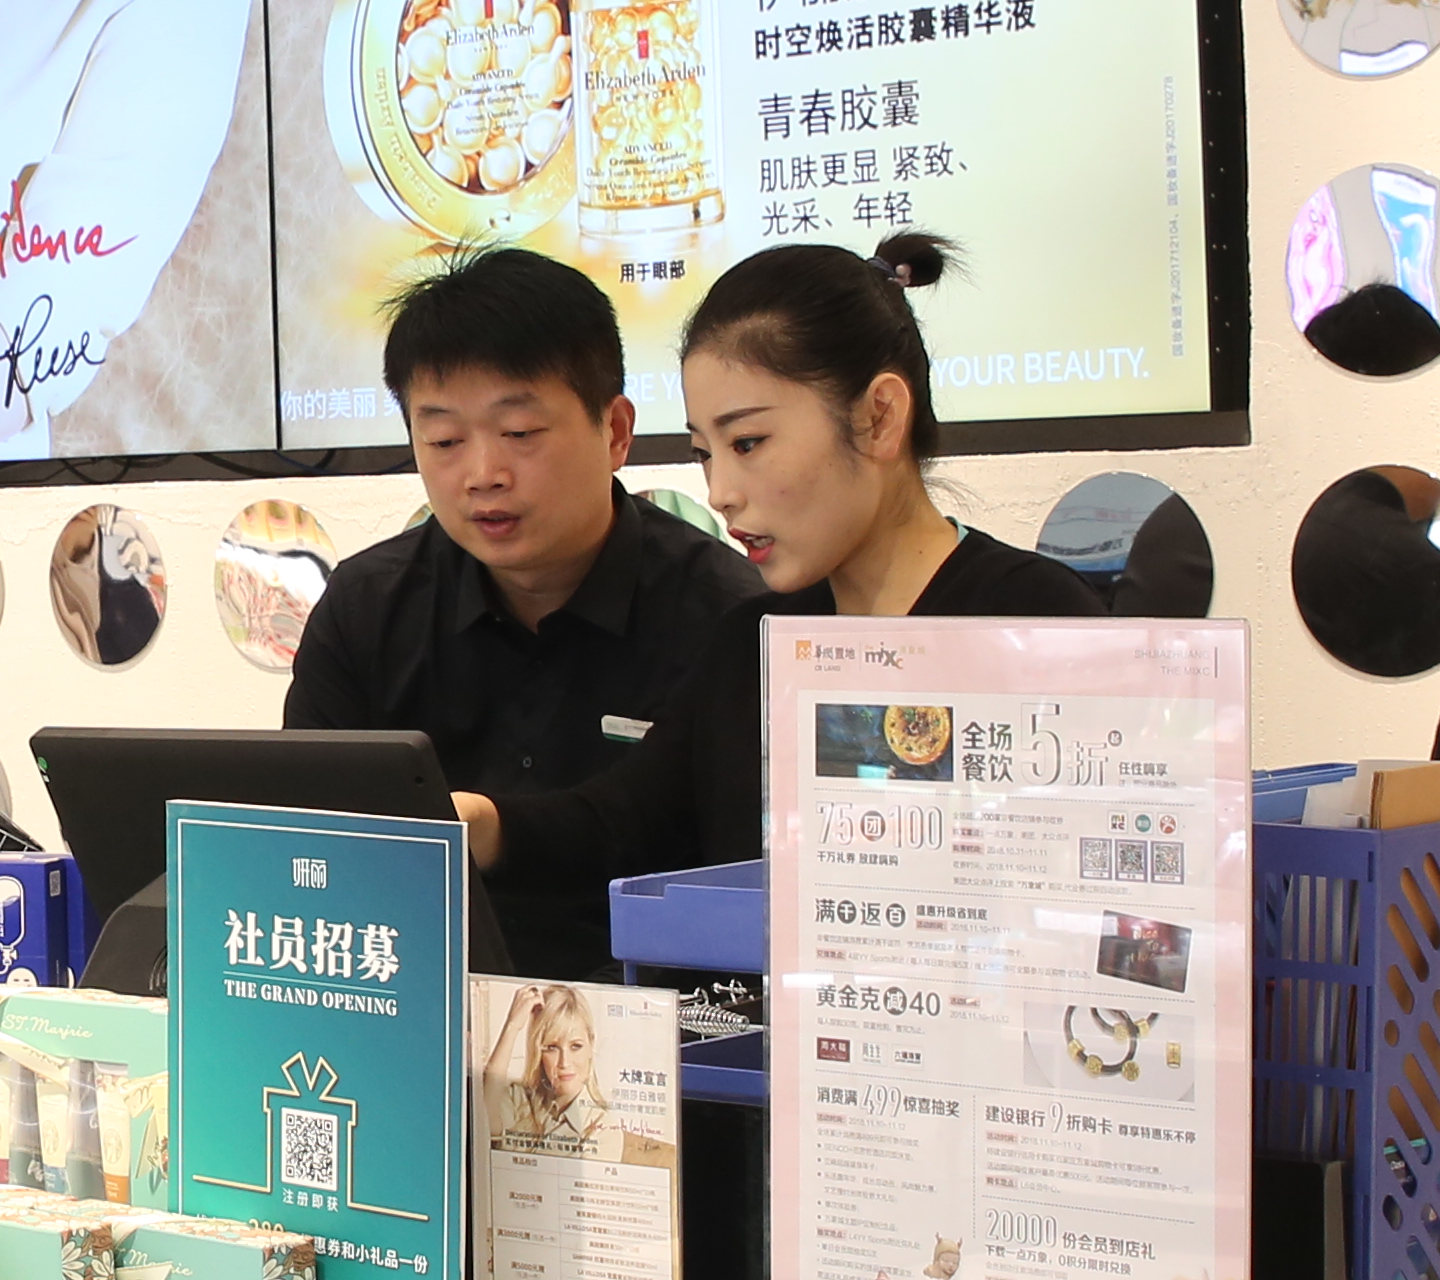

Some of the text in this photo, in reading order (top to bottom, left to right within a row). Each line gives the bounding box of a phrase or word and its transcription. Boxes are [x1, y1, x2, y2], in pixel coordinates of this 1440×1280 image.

[583, 61, 707, 92] Elizabeth Arden
[758, 80, 920, 141] 青春胶囊
[760, 148, 881, 193] 肌肤更显
[620, 260, 685, 283] 用于眼部
[932, 353, 1017, 387] YOUR
[280, 387, 377, 422] 你的美丽
[1134, 649, 1210, 661] SHIJIAZHUANG
[961, 721, 1012, 751] 全场
[961, 754, 1014, 783] 餐饮
[293, 857, 328, 890] 妍丽
[814, 897, 906, 928] 满千返百
[223, 908, 400, 984] 社员招募
[224, 978, 399, 1017] THE GRAND OPENING
[619, 1068, 668, 1087] 大牌宣言
[611, 1088, 667, 1102] 伊丽莎白雅顿
[282, 1186, 339, 1213] 注册即获
[1062, 1231, 1156, 1260] 份会员到店礼
